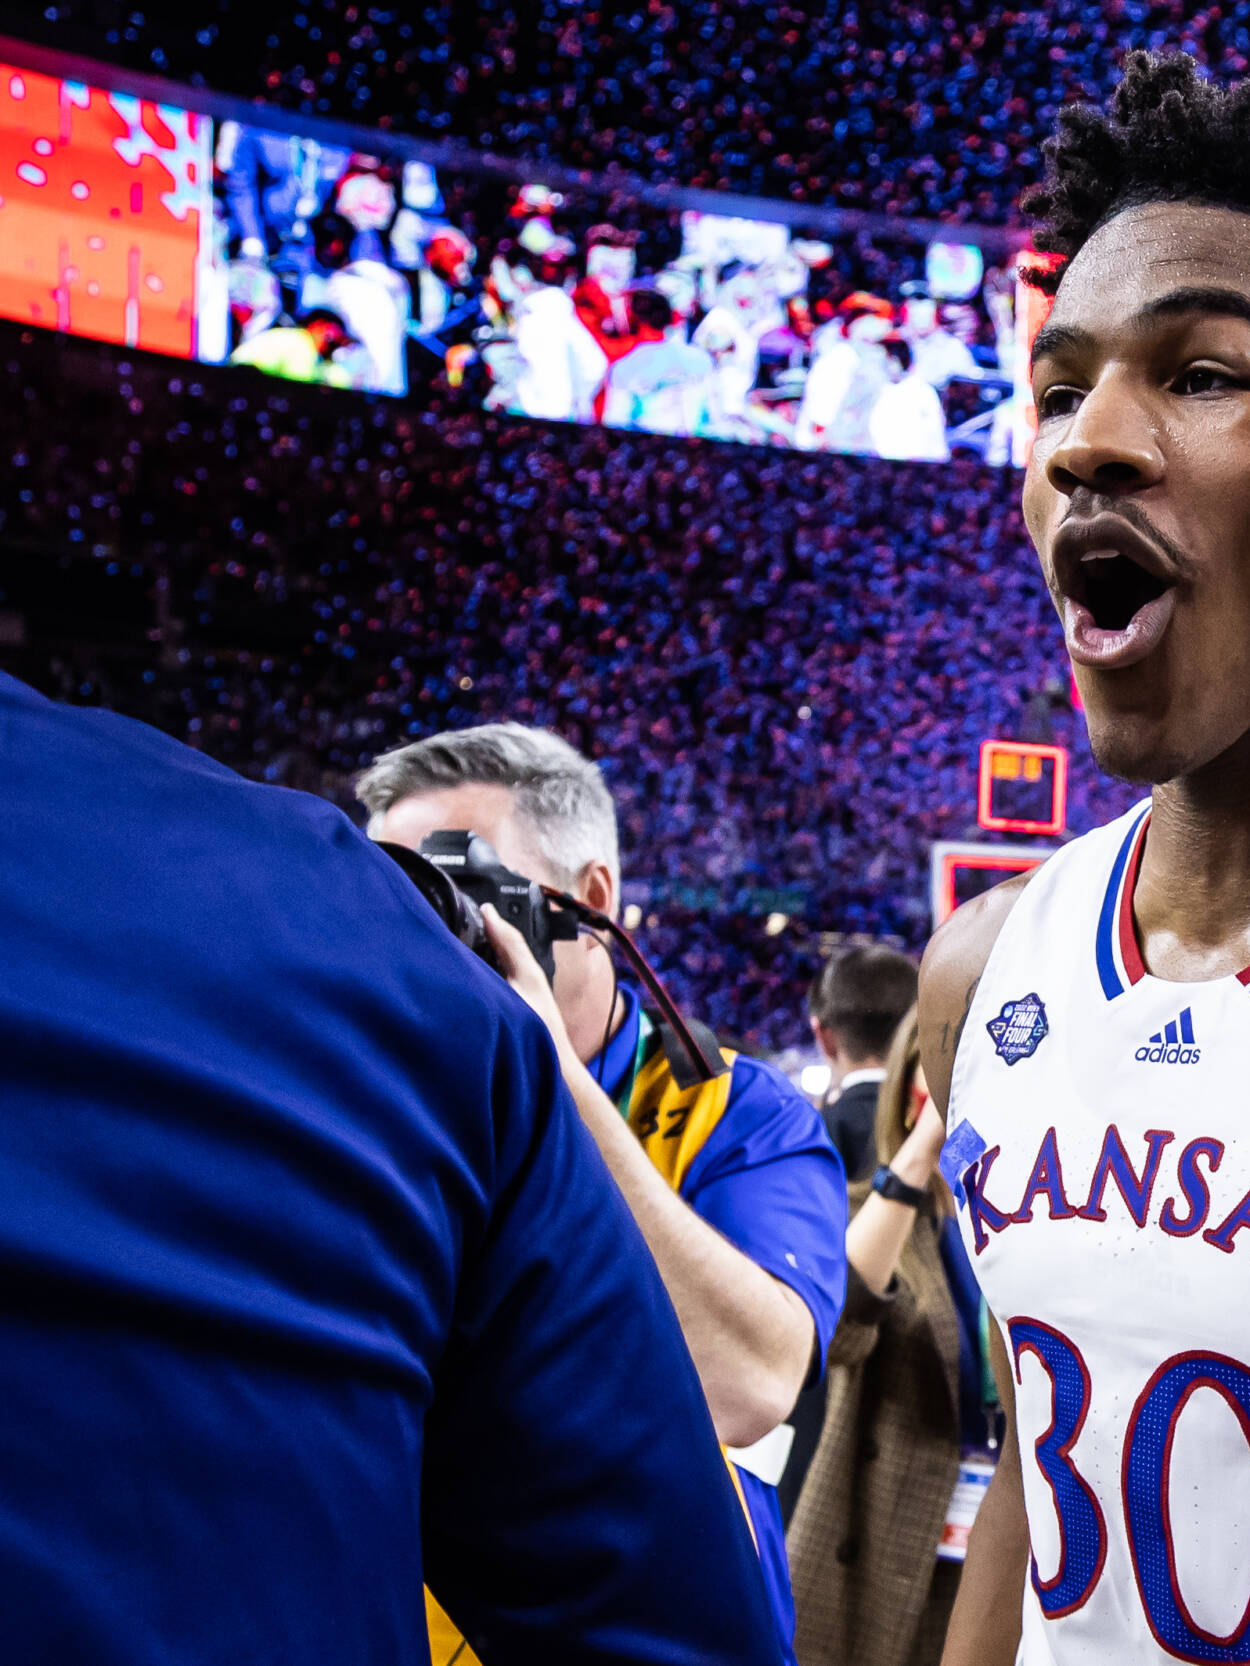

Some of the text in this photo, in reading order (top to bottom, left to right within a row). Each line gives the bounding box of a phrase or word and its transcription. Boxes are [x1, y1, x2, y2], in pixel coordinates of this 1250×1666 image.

[1009, 1011, 1039, 1028] FINAL
[1001, 1027, 1032, 1044] FOUR
[1135, 1043, 1201, 1064] adidas
